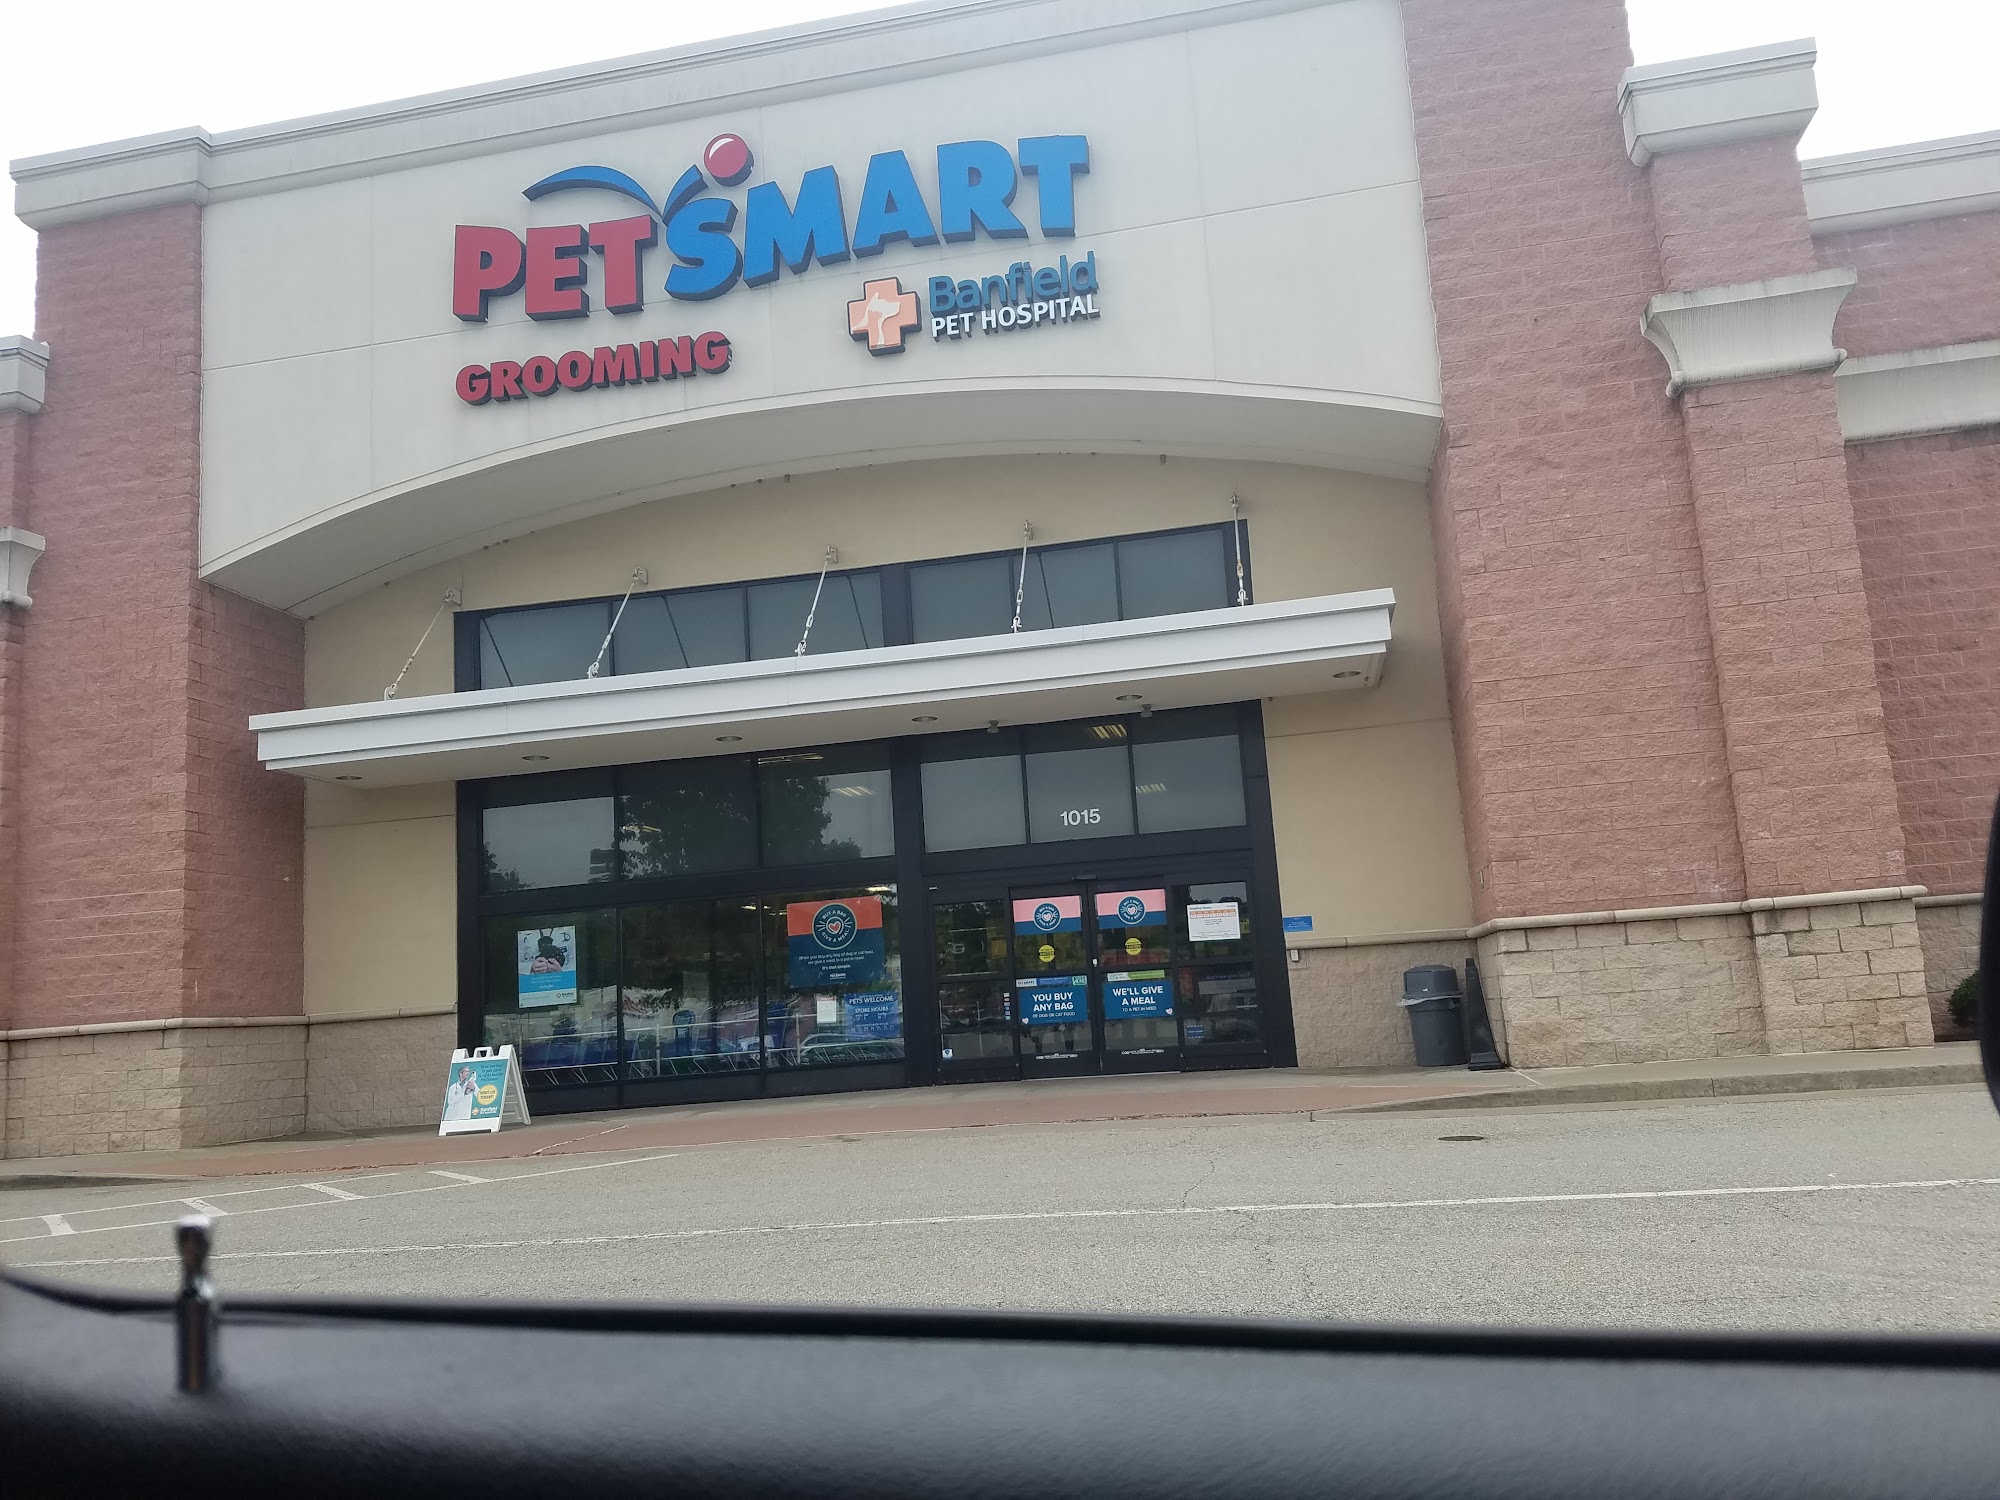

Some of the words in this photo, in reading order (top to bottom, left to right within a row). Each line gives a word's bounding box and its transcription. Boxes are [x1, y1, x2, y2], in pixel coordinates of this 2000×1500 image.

[453, 134, 1090, 322] PETSMART
[928, 251, 1098, 315] Banfield
[931, 312, 974, 339] PET
[982, 294, 1099, 332] HOSPITAL
[456, 330, 732, 404] GROOMING
[1060, 808, 1101, 826] 1015
[1032, 993, 1052, 1002] YOU
[1054, 991, 1073, 1000] BUY
[1112, 987, 1139, 996] WE'LL
[1141, 985, 1163, 994] GIVE
[864, 995, 894, 1003] WELCOME
[1122, 998, 1129, 1006] A
[1131, 996, 1156, 1005] MEAL
[1033, 1003, 1052, 1011] ANY
[1055, 1002, 1074, 1010] BAG
